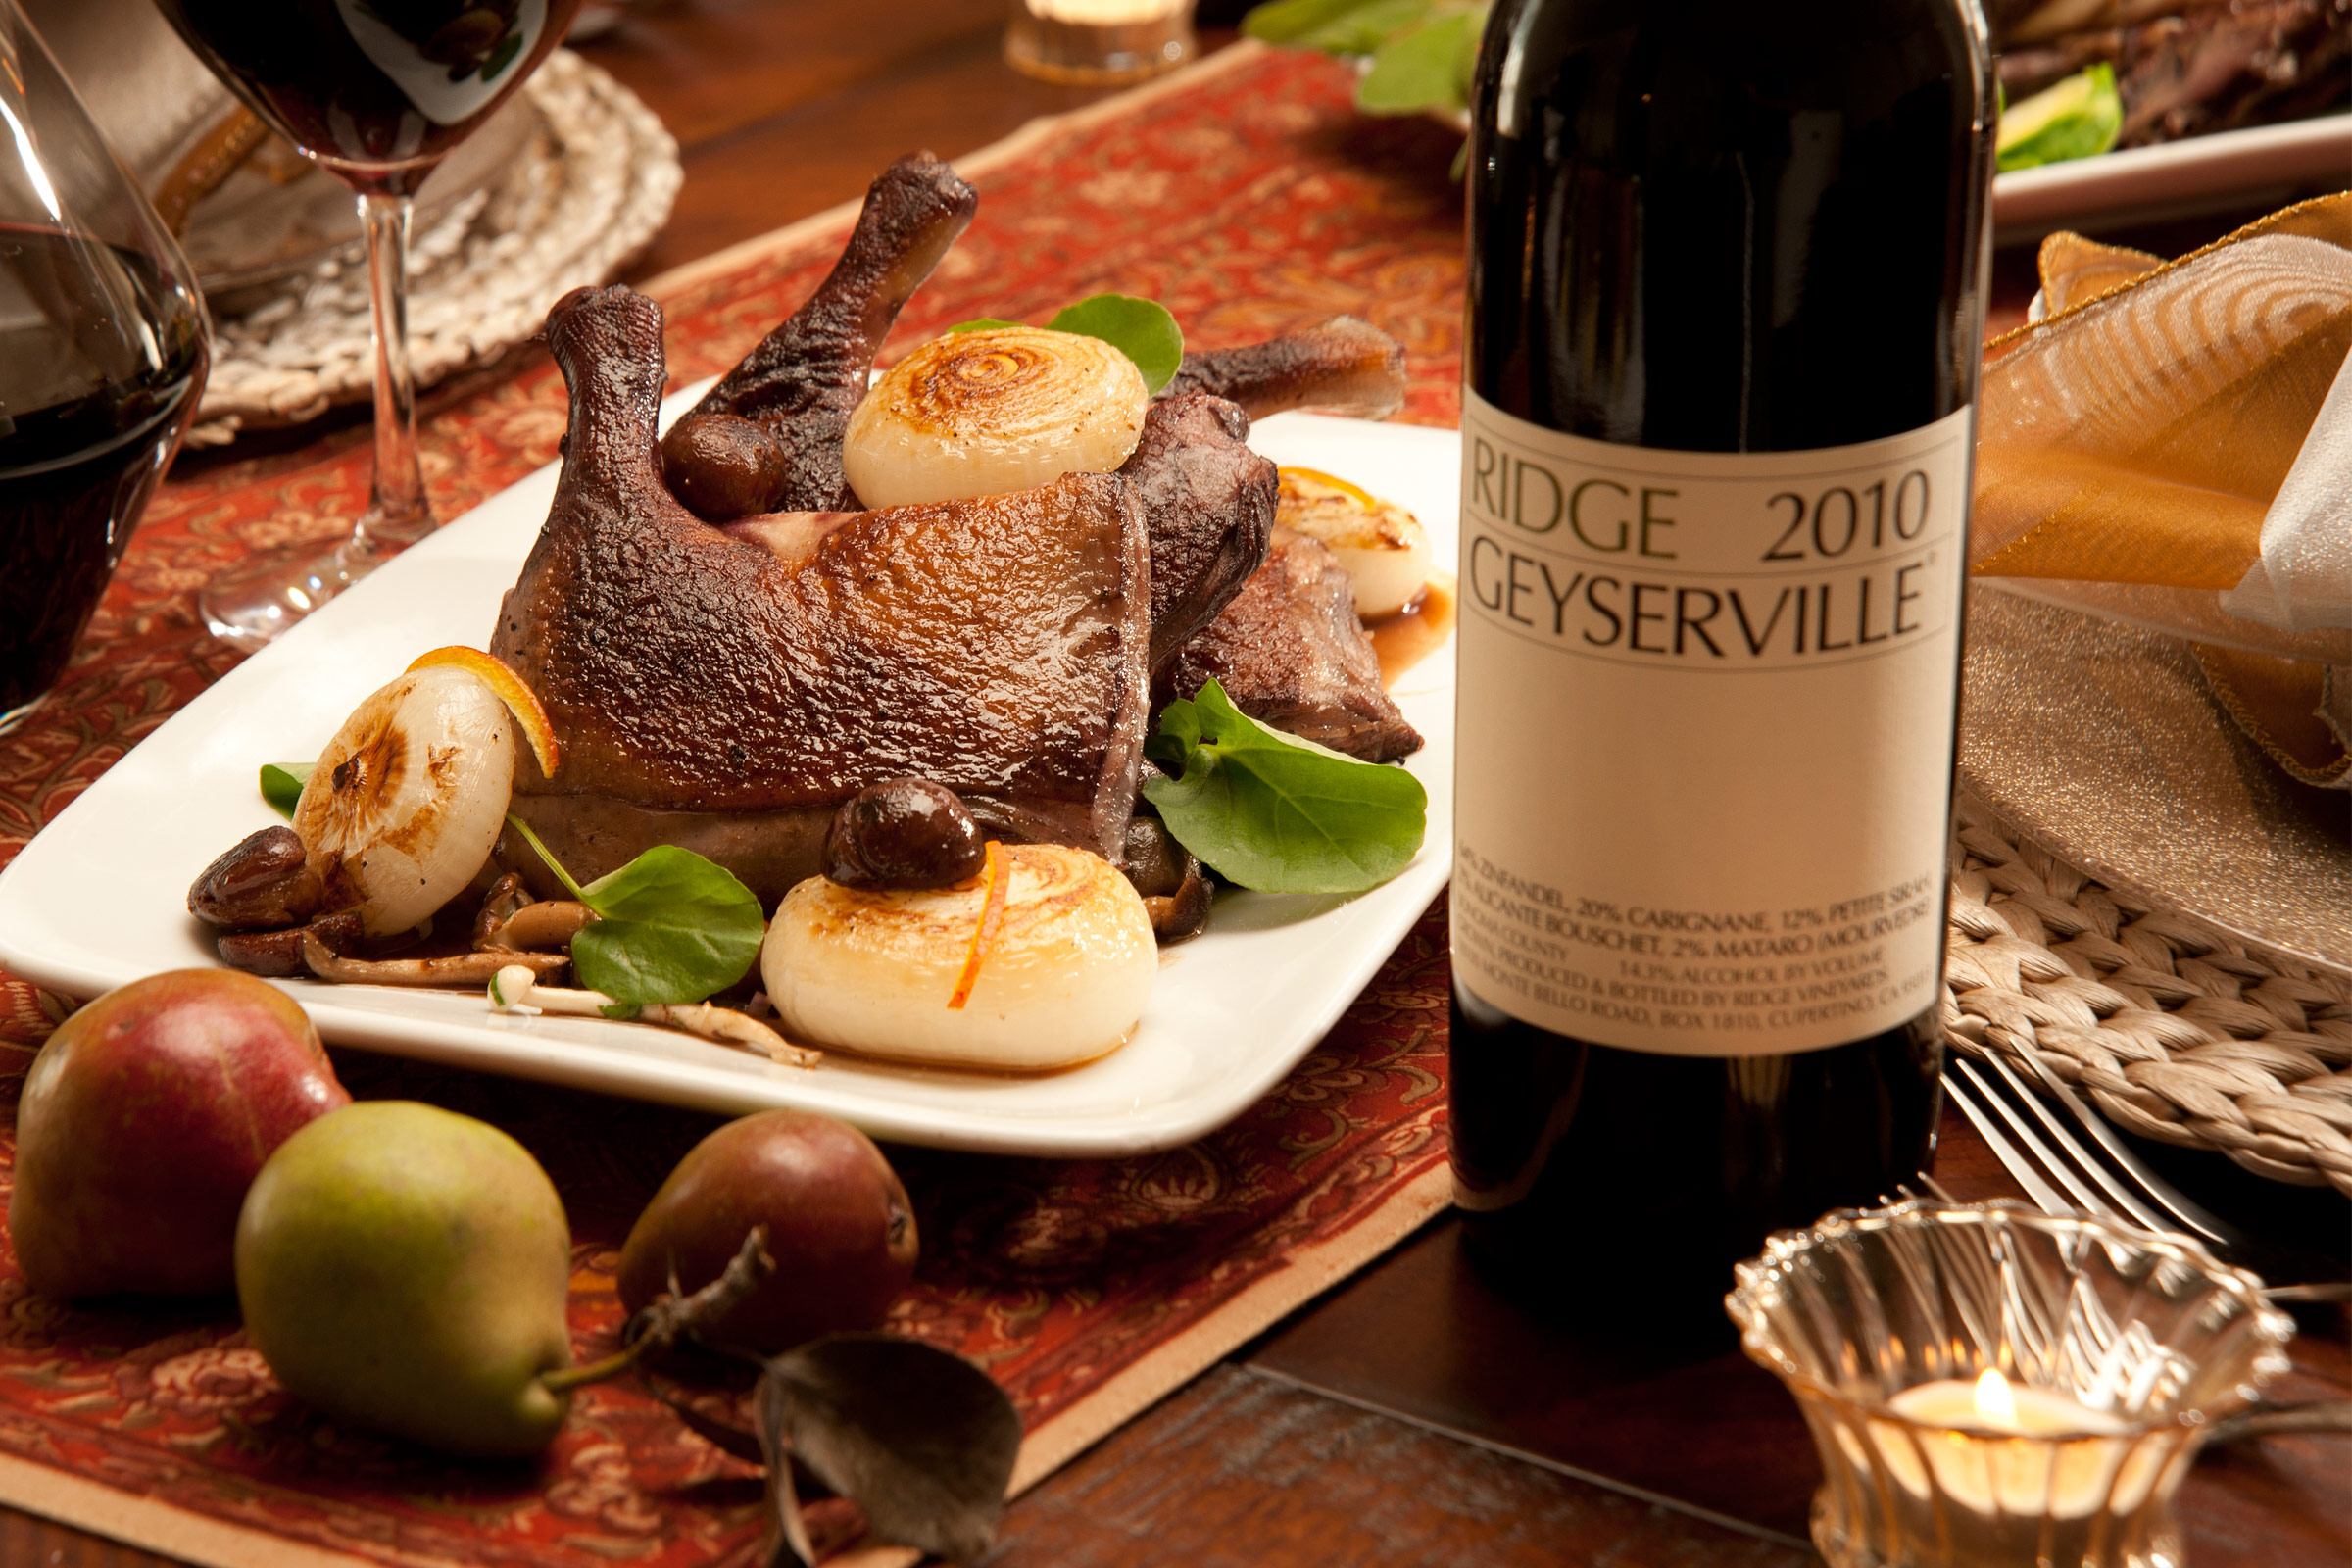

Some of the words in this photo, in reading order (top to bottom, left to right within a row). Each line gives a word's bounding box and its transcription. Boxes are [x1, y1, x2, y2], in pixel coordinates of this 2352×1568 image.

[1472, 436, 1679, 560] RIDGE
[1761, 468, 1931, 564] 2010
[1474, 880, 1542, 928] ALICANTE
[1545, 913, 1666, 958] BOUSCHET,
[1671, 937, 1709, 958] 2%
[1712, 934, 1815, 958] MATARO
[1577, 896, 1624, 923] 20%
[1627, 906, 1773, 933] CARIGNANE,
[1783, 907, 1825, 929] 12%
[1829, 891, 1885, 922] PETITE
[1497, 946, 1589, 990] PRODUCED
[1591, 976, 1604, 996] &
[1608, 980, 1699, 1007] BOTTLED
[1702, 988, 1727, 1007] BY
[1733, 986, 1791, 1007] RIDGE
[1500, 924, 1569, 962] COUNTY
[1682, 965, 1778, 985] ALCOHOL
[1784, 962, 1806, 983] BY
[1809, 944, 1886, 978] VOLUME
[1533, 982, 1588, 1014] BELLO
[1659, 1009, 1705, 1030] BOX
